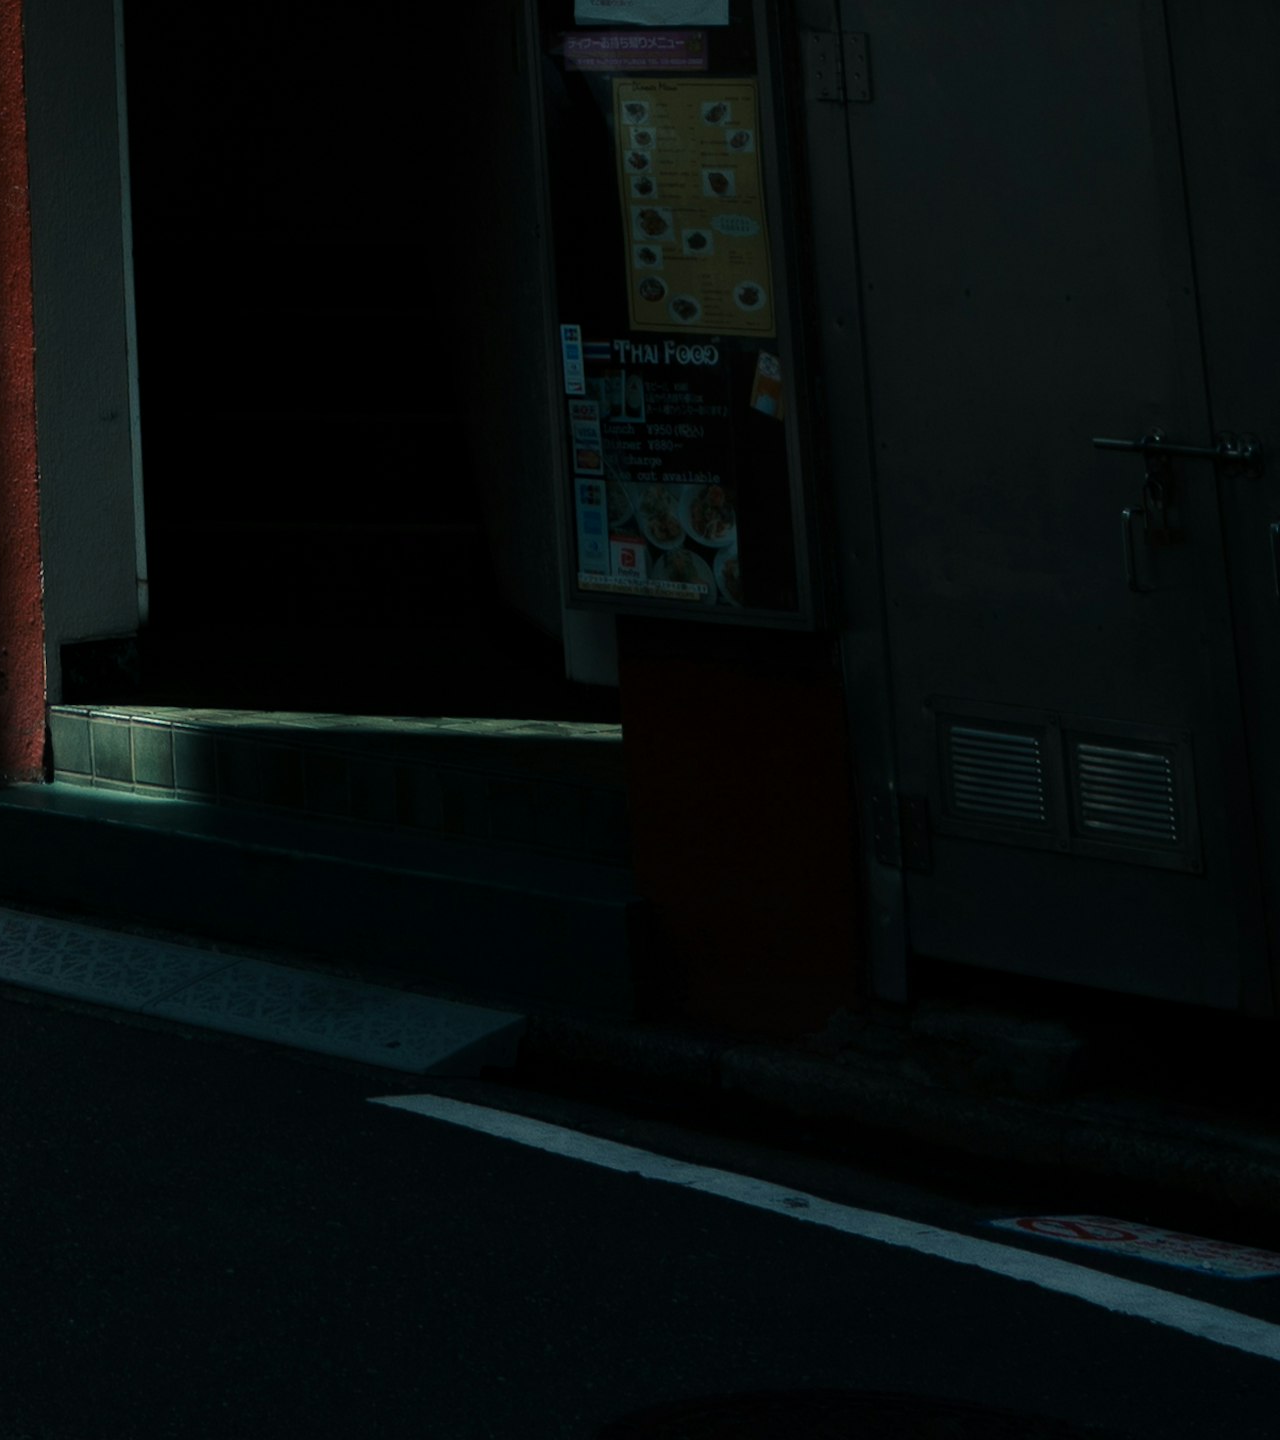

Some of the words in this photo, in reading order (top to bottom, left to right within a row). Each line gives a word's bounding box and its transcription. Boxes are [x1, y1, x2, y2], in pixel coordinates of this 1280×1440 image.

[603, 423, 636, 436] Lunch
[637, 472, 658, 482] out
[662, 471, 721, 484] available
